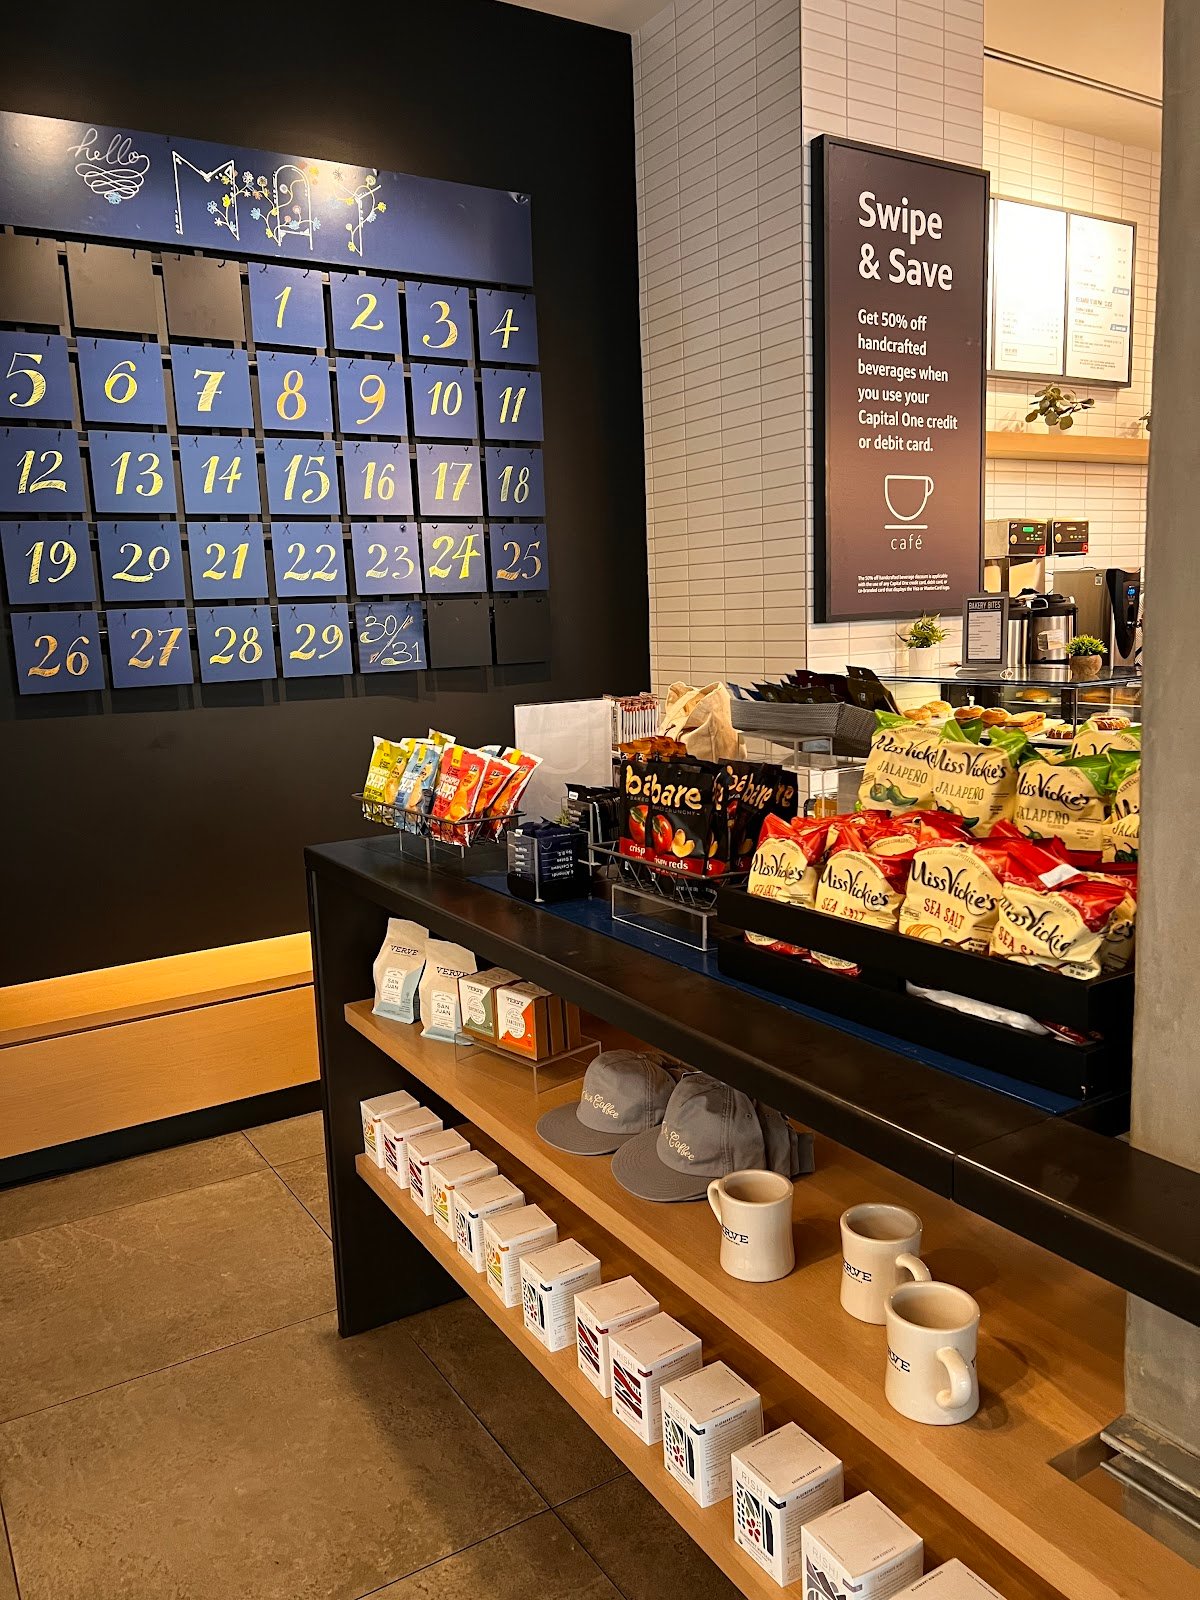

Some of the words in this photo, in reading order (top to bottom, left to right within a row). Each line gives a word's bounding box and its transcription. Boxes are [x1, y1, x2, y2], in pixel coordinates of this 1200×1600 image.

[68, 127, 146, 164] hello
[171, 150, 384, 257] MAY
[858, 191, 943, 245] Swipe
[858, 243, 881, 280] &
[888, 248, 953, 291] Save
[274, 287, 292, 329] 1
[350, 293, 384, 332] 2
[422, 301, 458, 349] 3
[858, 309, 879, 326] Get
[881, 312, 907, 330] 50%
[910, 315, 927, 331] off
[490, 309, 520, 350] 4
[858, 333, 927, 356] handcrafted
[6, 352, 46, 407] 5
[104, 360, 138, 404] 6
[858, 359, 917, 382] beverages
[919, 367, 948, 382] when
[193, 369, 226, 411] 7
[276, 370, 307, 421] 8
[356, 374, 386, 425] 9
[427, 381, 462, 416] 10
[499, 387, 527, 424] 11
[858, 388, 879, 403] you
[882, 389, 902, 401] use
[905, 391, 929, 405] your
[858, 409, 899, 428] Capital
[901, 413, 924, 428] One
[926, 414, 958, 430] credit
[858, 436, 871, 449] or
[874, 435, 904, 451] debit
[906, 437, 933, 452] card.
[15, 450, 67, 494] 12
[110, 451, 164, 497] 13
[201, 455, 242, 494] 14
[283, 454, 330, 504] 15
[362, 462, 395, 501] 16
[432, 462, 473, 501] 17
[498, 465, 530, 504] 18
[428, 534, 481, 581] 24
[495, 541, 542, 581] 25
[890, 534, 923, 550] café
[25, 540, 78, 584] 19
[112, 543, 170, 582] 20
[202, 542, 250, 581] 21
[283, 542, 338, 582] 22
[366, 544, 415, 581] 23
[969, 601, 987, 610] BAKERY
[988, 600, 1001, 609] BITES
[28, 635, 89, 677] 26
[128, 627, 183, 669] 27
[209, 626, 263, 665] 28
[289, 623, 344, 661] 29
[871, 735, 904, 755] Miss
[905, 740, 936, 770] Vicki
[962, 752, 1007, 786] Vickie's
[741, 772, 773, 810] bare
[877, 760, 928, 784] JALAPEÑO
[935, 781, 985, 800] JALAPEÑO
[651, 773, 702, 810] bare
[1037, 773, 1090, 811] Vickie's
[1017, 806, 1070, 825] JALAPEÑO
[629, 844, 646, 856] crisp
[669, 859, 689, 870] reds
[751, 853, 774, 876] Miss
[771, 853, 804, 886] Vickie's
[820, 863, 847, 892] Miss
[845, 868, 889, 912] Vickie's
[911, 859, 946, 891] Miss
[942, 866, 997, 916] Vickie's
[821, 897, 838, 913] SEA
[840, 906, 866, 921] SALT
[924, 898, 941, 919] SEA
[944, 907, 965, 929] SALT
[391, 945, 418, 956] VERVE
[998, 926, 1015, 952] SEA
[593, 1094, 619, 1119] Coffee
[669, 1131, 695, 1161] Coffee
[722, 1226, 749, 1244] RVE
[842, 1259, 872, 1282] RVE
[741, 1471, 766, 1500] RISHI
